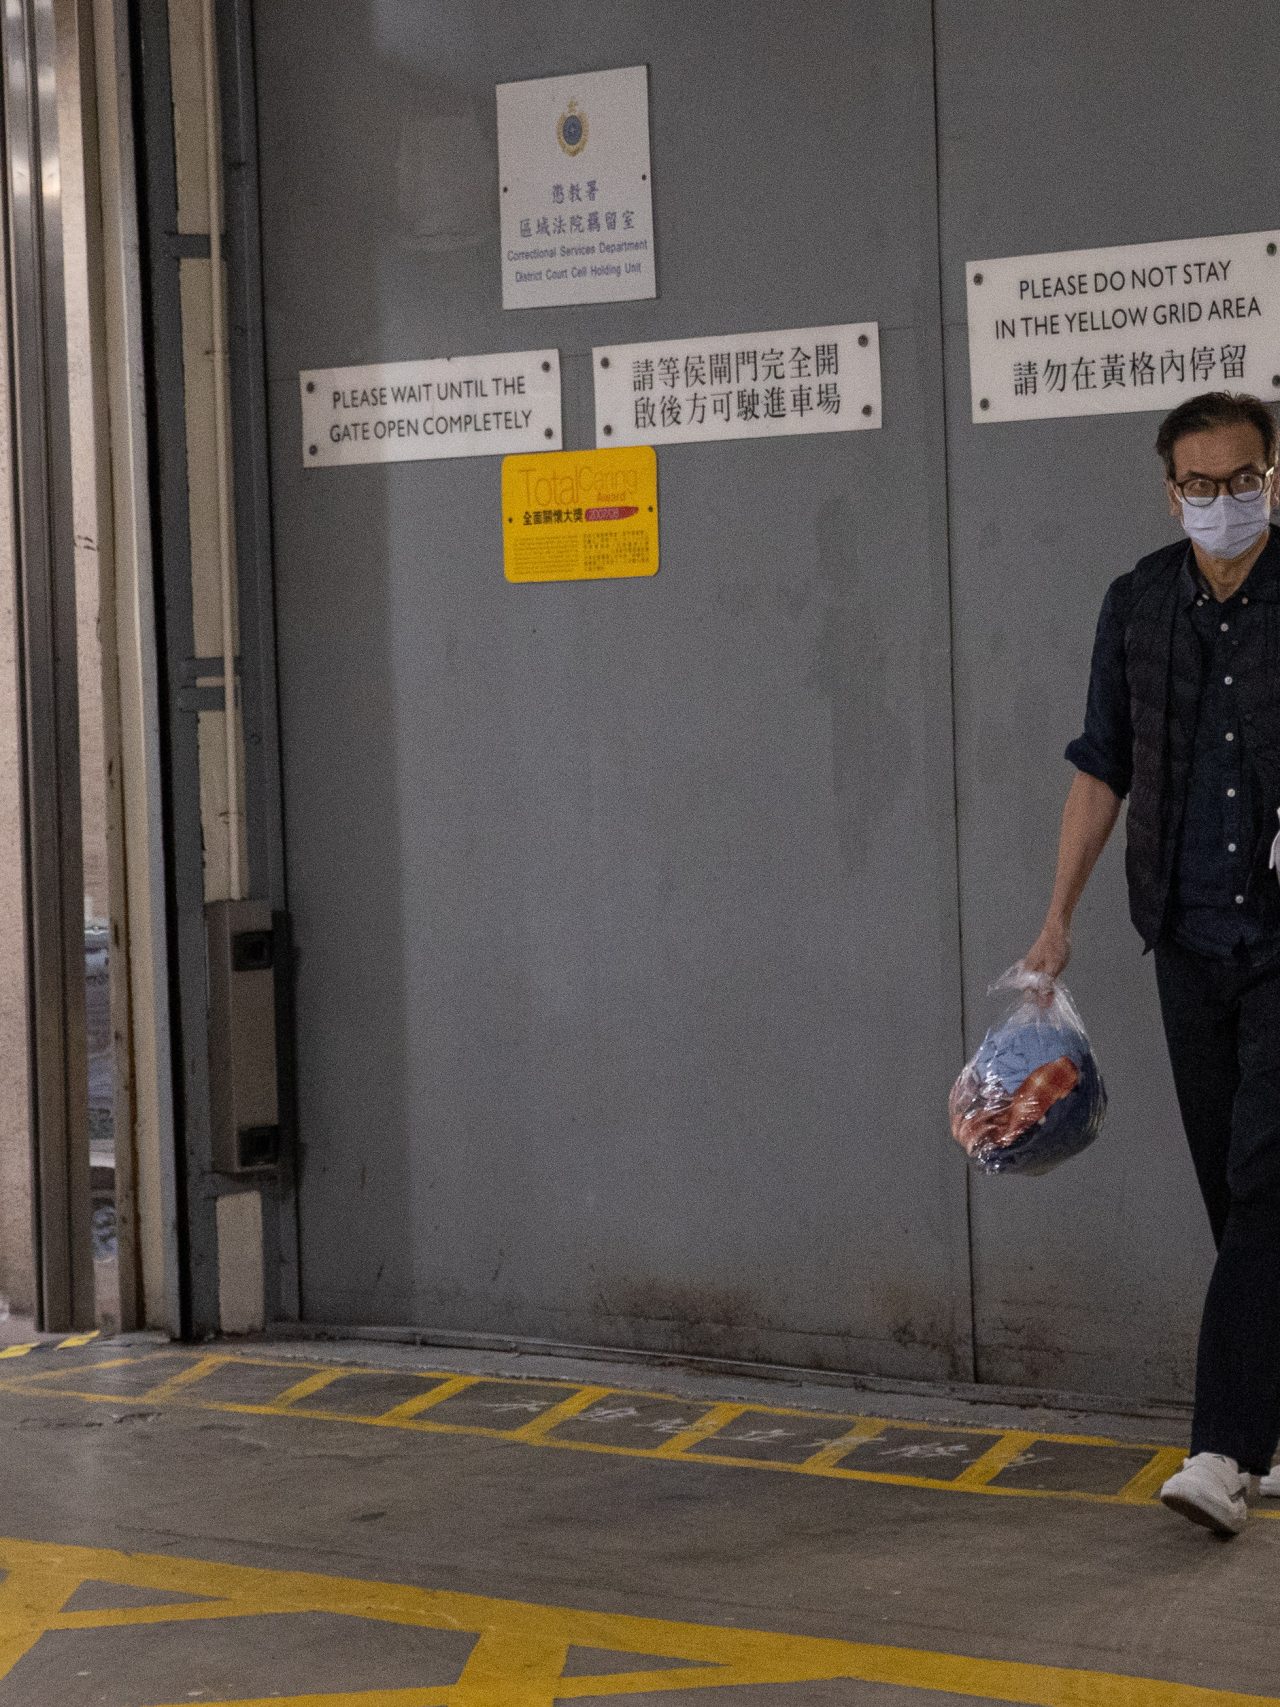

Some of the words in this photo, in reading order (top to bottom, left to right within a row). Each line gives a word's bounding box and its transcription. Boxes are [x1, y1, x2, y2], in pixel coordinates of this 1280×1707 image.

[507, 247, 556, 261] Correctional
[560, 245, 595, 257] Services
[599, 240, 647, 254] Department
[515, 271, 542, 282] District
[545, 269, 568, 280] Court
[590, 265, 621, 277] Holding
[624, 263, 641, 274] Unit
[1019, 274, 1088, 300] PLEASE
[1094, 270, 1125, 293] DO
[1132, 265, 1177, 289] NOT
[1183, 260, 1231, 284] STAY
[995, 319, 1015, 340] IN
[1020, 314, 1060, 337] THE
[1065, 306, 1148, 333] YELLOW
[1153, 302, 1202, 325] GRID
[1208, 296, 1262, 321] AREA
[1013, 344, 1246, 396] 請勿在黃格內停留
[332, 387, 388, 409] PLEASE
[391, 383, 433, 403] WAIT
[437, 379, 488, 400] UNTIL
[491, 376, 526, 396] THE
[634, 382, 841, 430] 啟後方可駛進車場
[329, 422, 370, 443] GATE
[373, 418, 419, 441] OPEN
[423, 410, 532, 436] COMPLETELY
